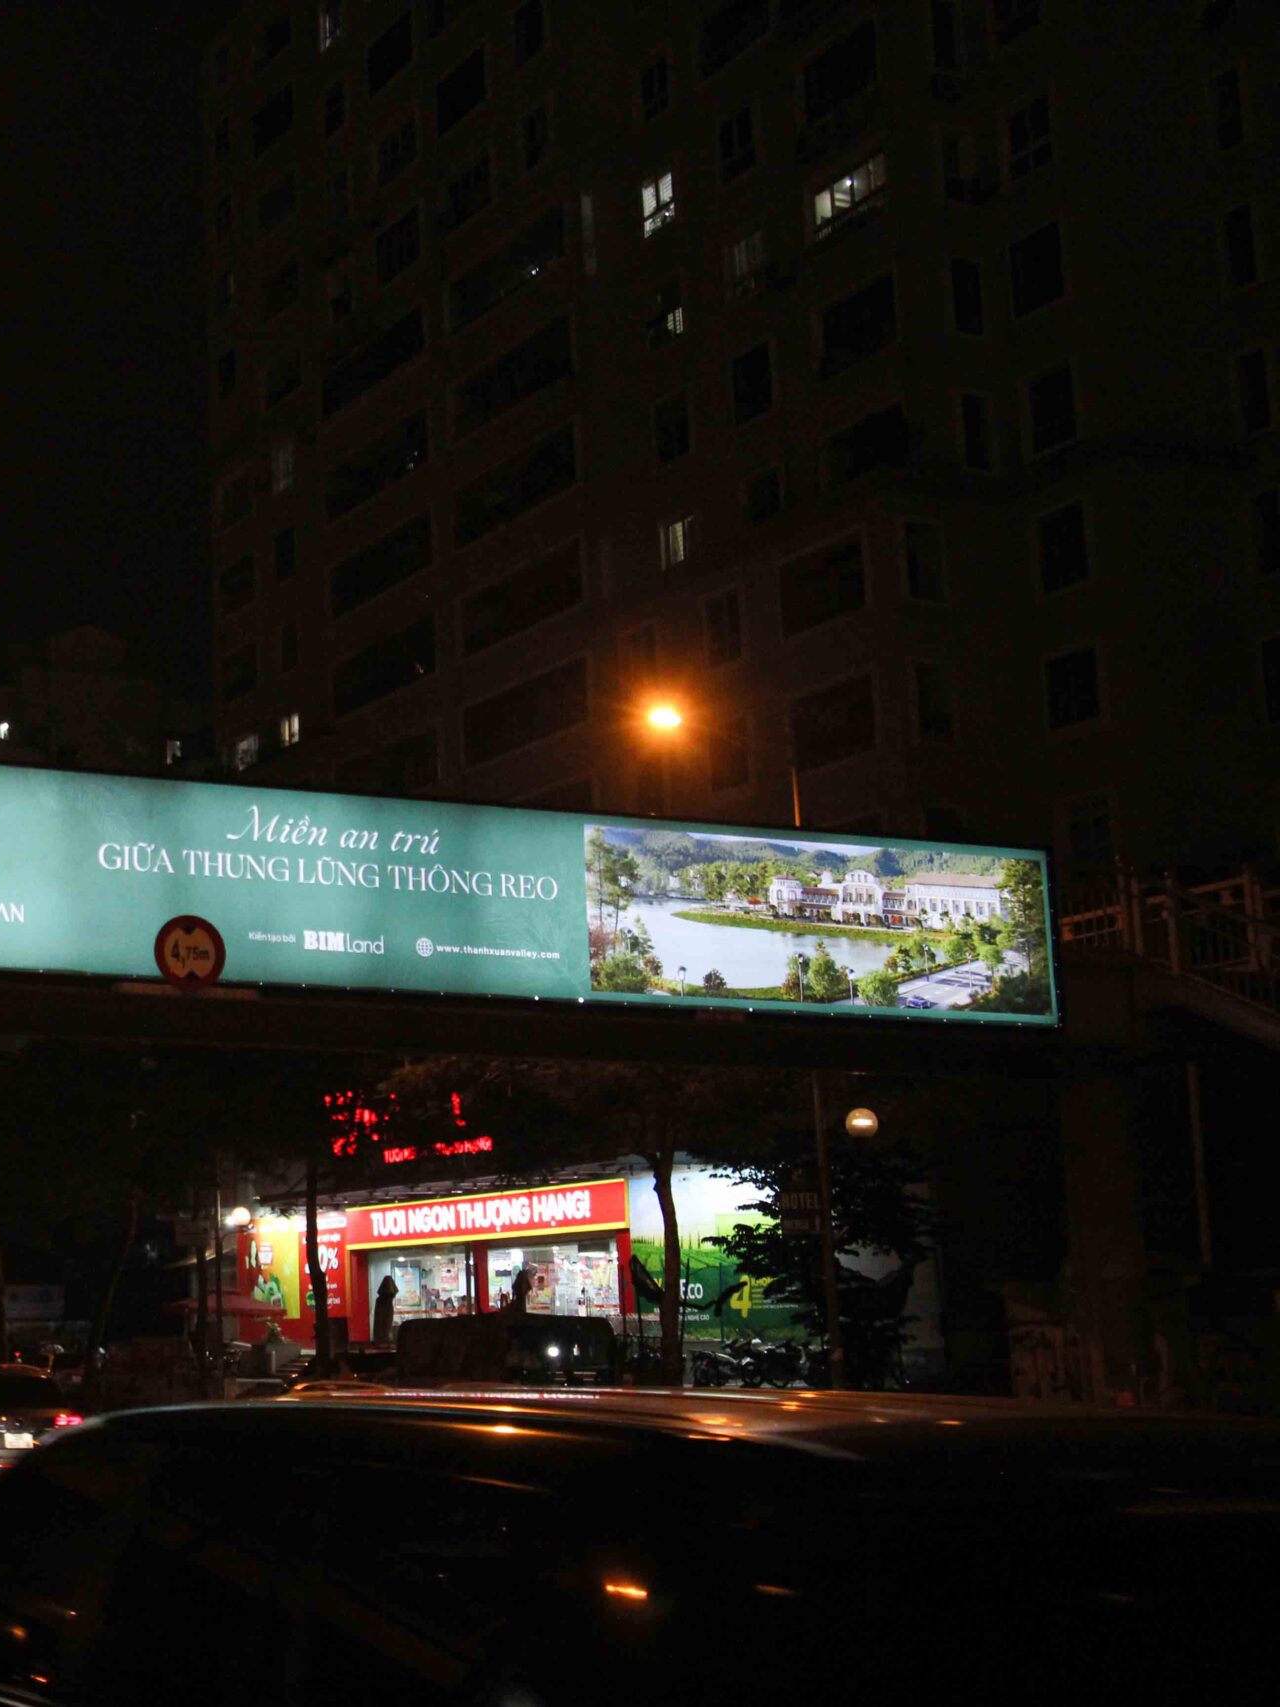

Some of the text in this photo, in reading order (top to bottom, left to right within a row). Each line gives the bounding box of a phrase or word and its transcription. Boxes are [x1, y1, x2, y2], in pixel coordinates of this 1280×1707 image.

[226, 804, 440, 855] Miền an trú
[98, 842, 559, 901] GIỮA THUNG LŨNG THÔNG REO
[436, 945, 561, 960] www.thanhxuanvalley.com
[408, 1203, 456, 1232] NGON
[532, 1189, 592, 1227] HẠNG!
